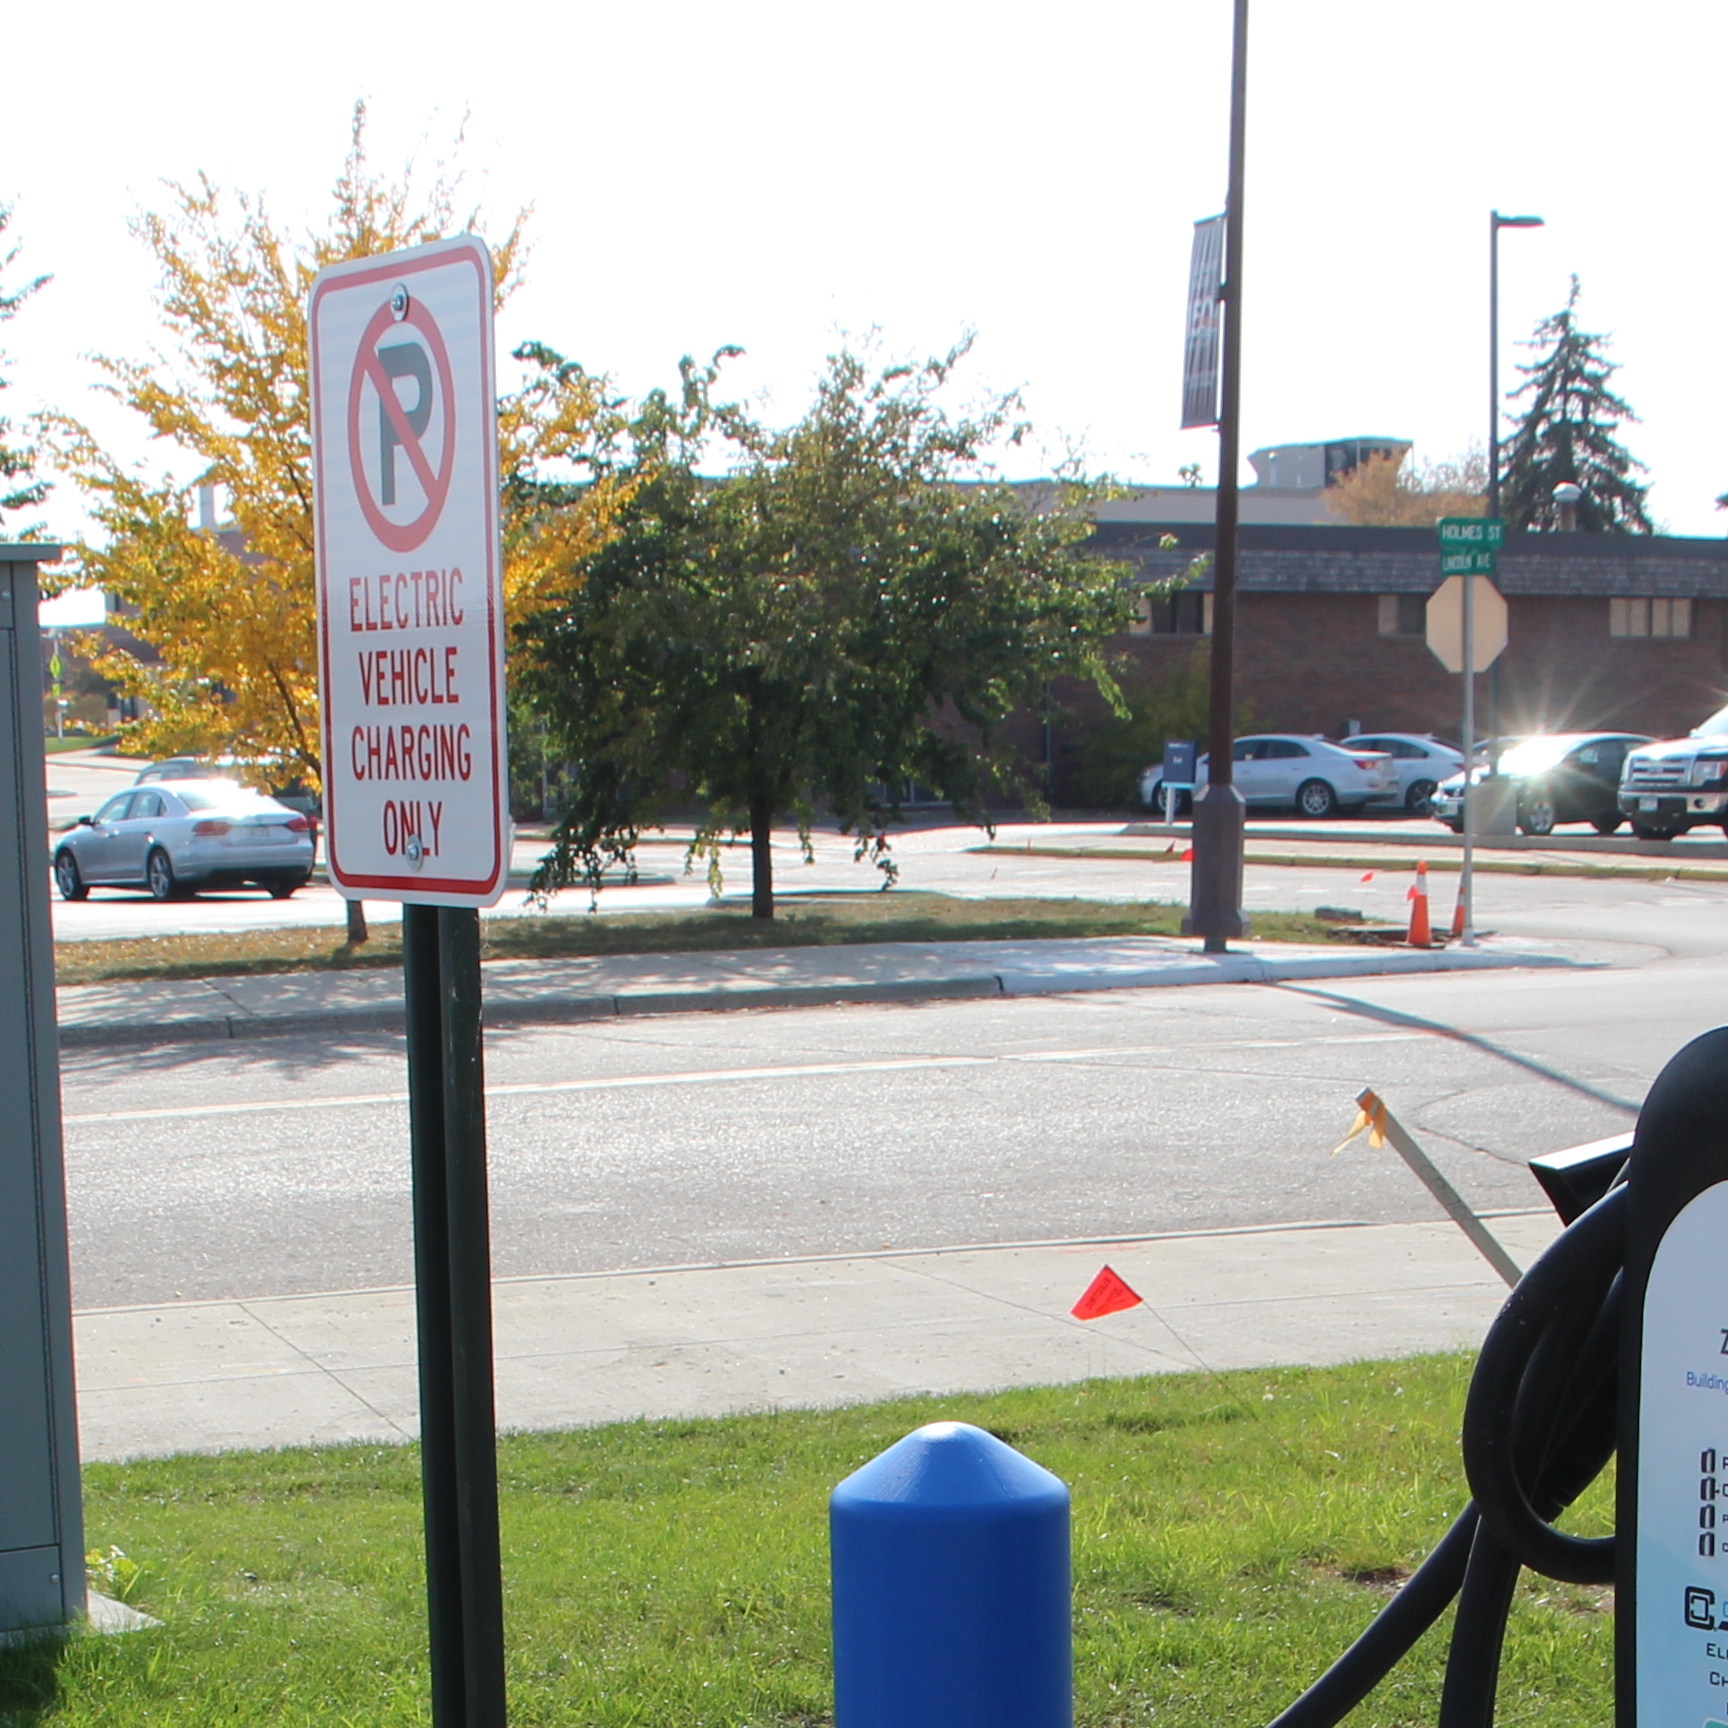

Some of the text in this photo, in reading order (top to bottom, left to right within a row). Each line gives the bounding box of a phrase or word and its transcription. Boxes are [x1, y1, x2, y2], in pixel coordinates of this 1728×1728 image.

[1442, 524, 1501, 540] HOLMES ST
[349, 567, 464, 632] ELECTRIC
[358, 646, 459, 706] VEHICLE
[351, 723, 471, 781] CHARGING
[383, 800, 443, 857] ONLY
